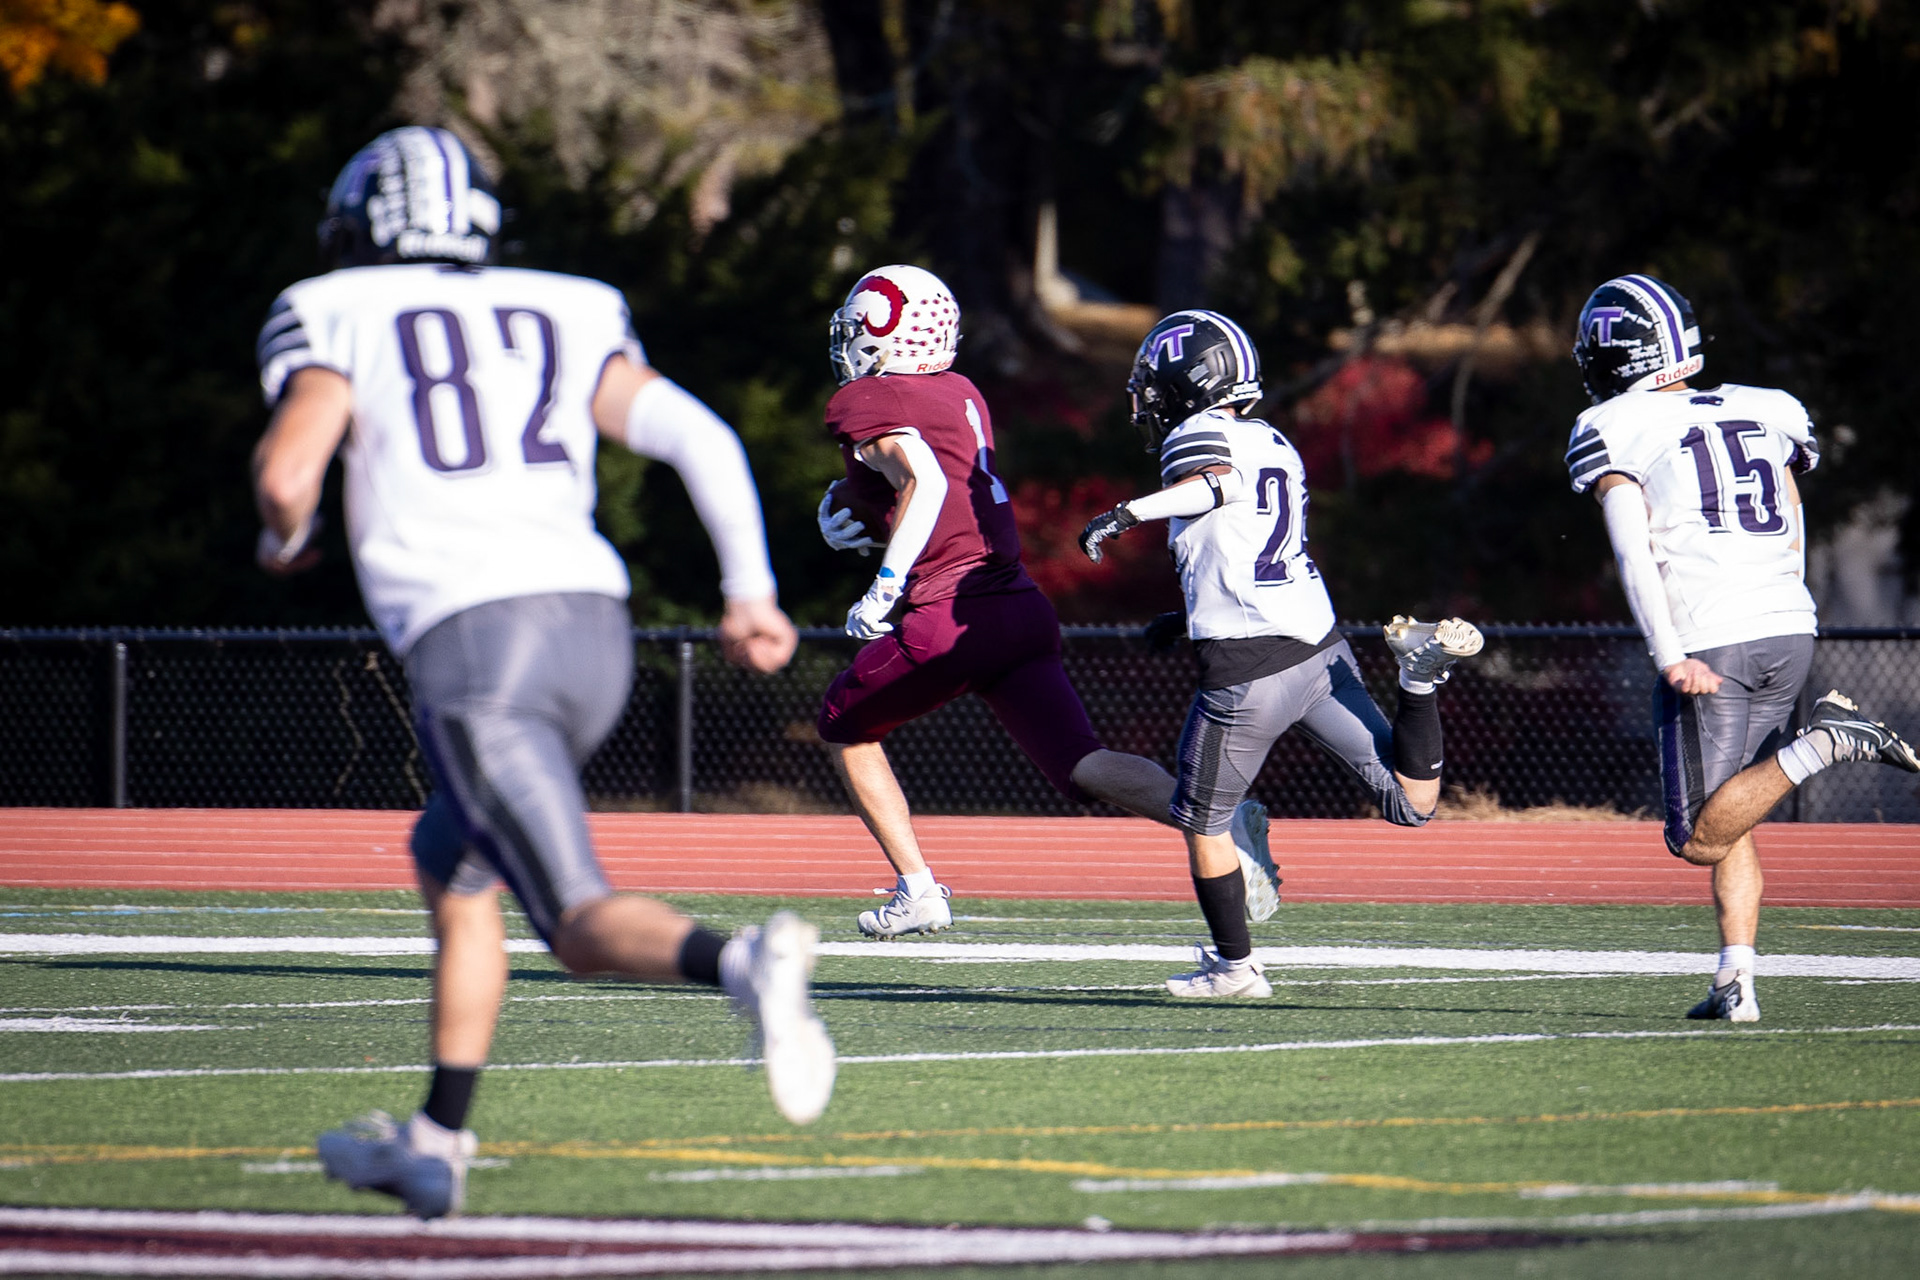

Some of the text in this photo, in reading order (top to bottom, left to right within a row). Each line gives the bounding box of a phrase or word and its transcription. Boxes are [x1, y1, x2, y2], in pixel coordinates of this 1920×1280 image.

[394, 308, 578, 479] 82
[1253, 466, 1319, 588] 2
[1680, 419, 1789, 537] 15
